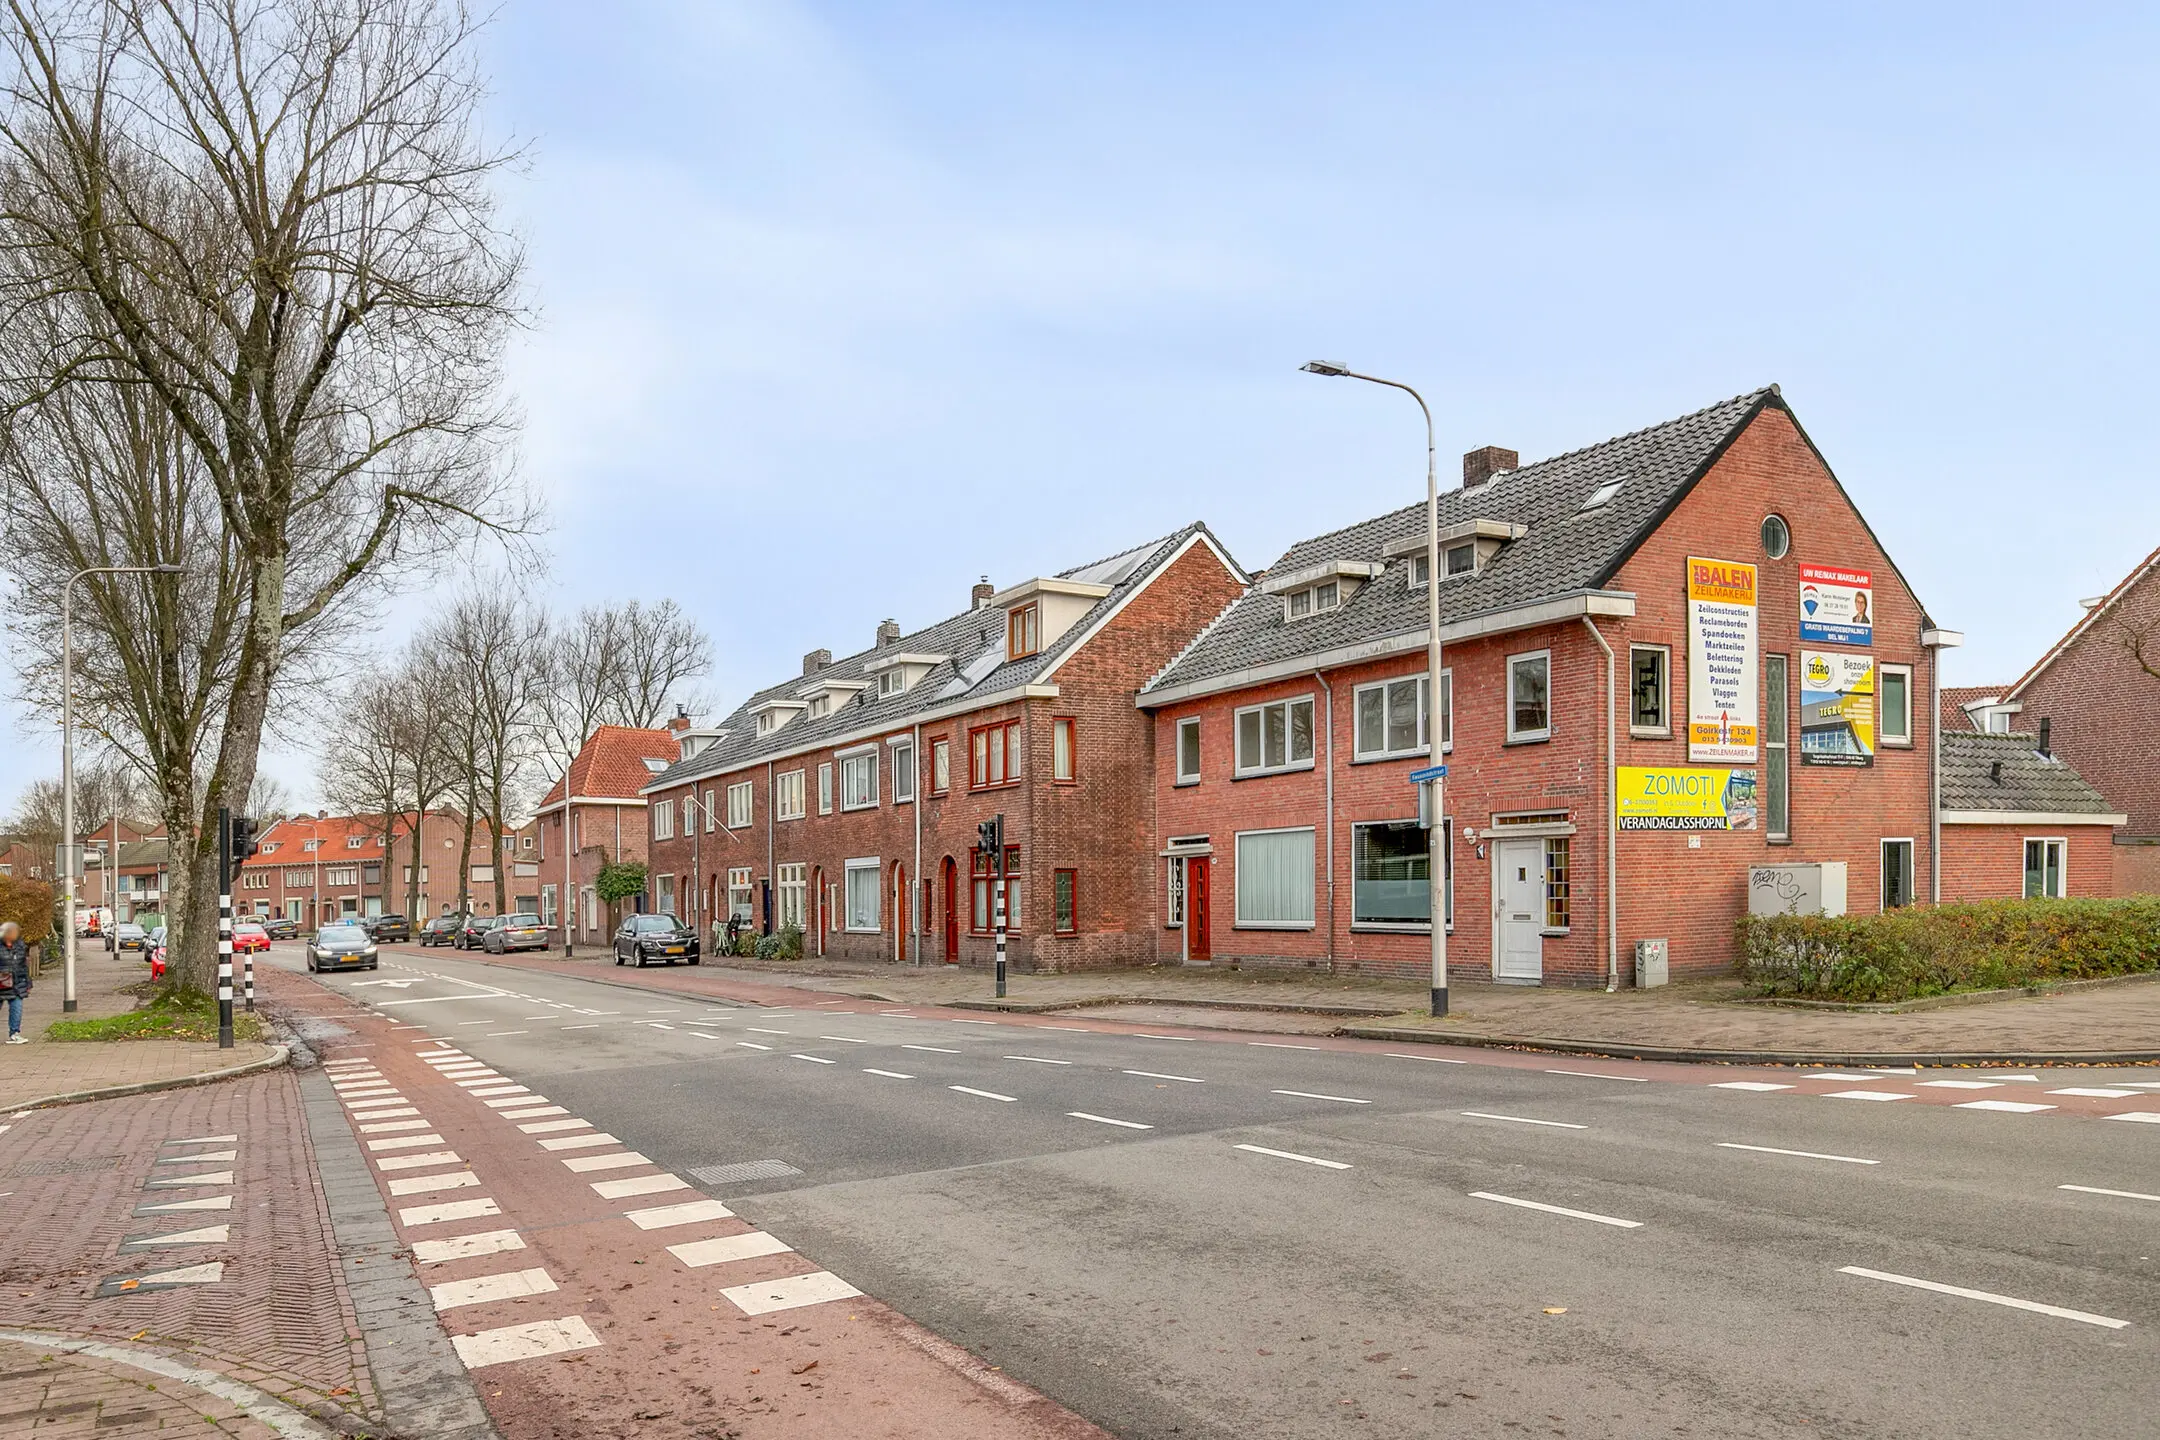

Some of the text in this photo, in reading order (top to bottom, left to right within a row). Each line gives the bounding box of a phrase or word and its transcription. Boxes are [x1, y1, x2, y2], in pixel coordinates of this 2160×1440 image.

[1699, 566, 1752, 589] BALEN
[1803, 569, 1813, 577] UW
[1837, 574, 1868, 583] MAKELAAR
[1695, 586, 1752, 600] ZEILMAKERIJ
[1698, 605, 1749, 616] Zeilconstructies
[1699, 616, 1748, 629] Reclameborden
[1702, 628, 1745, 640] Spandoeken
[1705, 640, 1745, 651] Marktzeilen
[1706, 653, 1743, 664] Belettering
[1709, 665, 1742, 675] Dekkleden
[1808, 664, 1830, 675] TEGRO
[1844, 660, 1871, 671] Bezoek
[1710, 676, 1739, 686] Parasols
[1712, 688, 1737, 699] Vlaggen
[1714, 700, 1735, 709] Tenten
[1820, 705, 1842, 718] TEGRO
[1737, 728, 1751, 736] 134
[1692, 749, 1755, 757] www.ZEILENMAKER.nl
[1644, 775, 1715, 795] ZOMOTI
[1620, 817, 1727, 830] VERANDAGLASSHOP.NL
